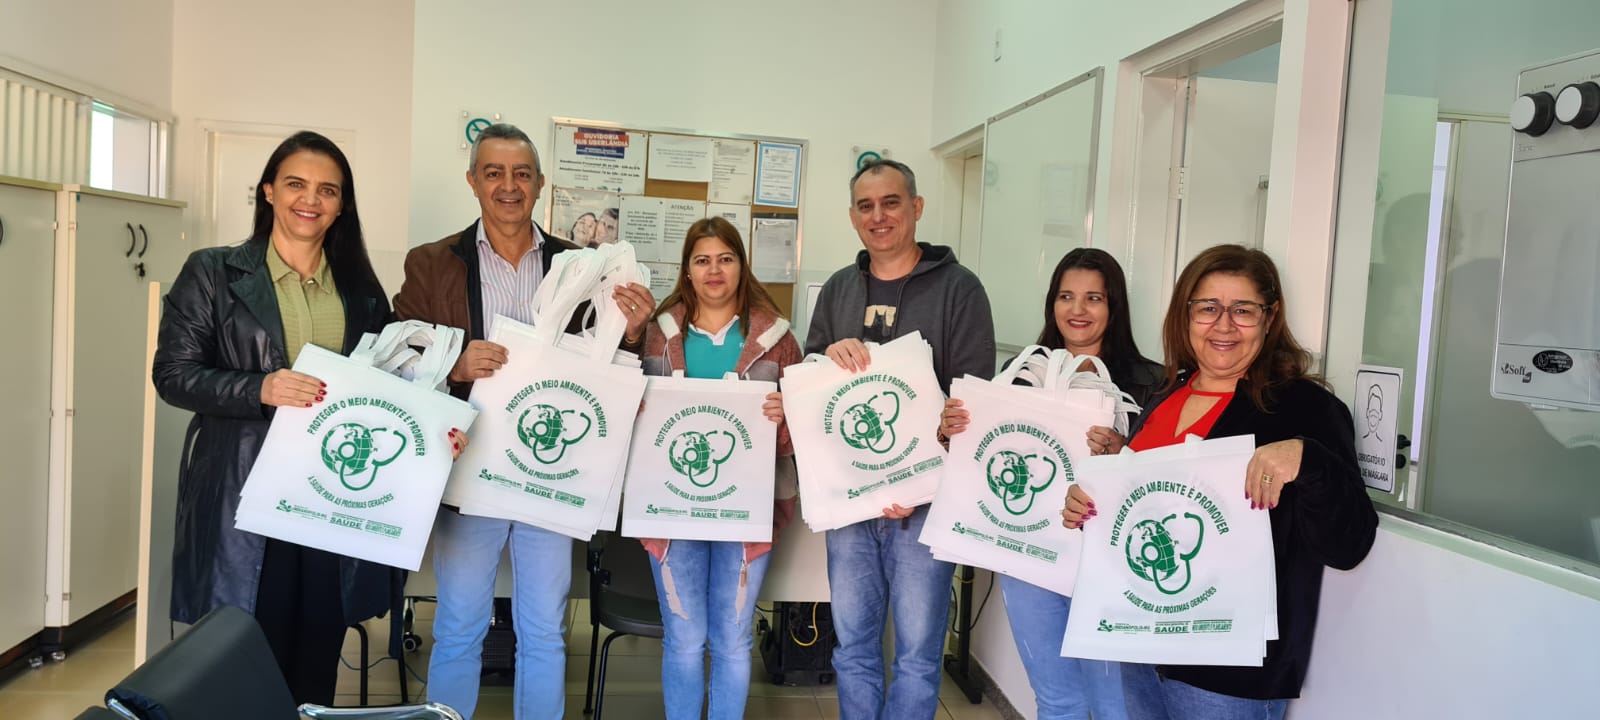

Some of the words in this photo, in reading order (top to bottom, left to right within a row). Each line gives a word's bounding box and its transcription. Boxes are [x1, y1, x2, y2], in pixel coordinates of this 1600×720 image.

[307, 403, 340, 435] PROTEGER
[340, 400, 346, 409] O
[348, 397, 367, 406] MEIO
[369, 398, 407, 419] AMBIENTE
[408, 418, 425, 456] PROMOVER
[506, 384, 535, 413] PROTEGER
[535, 382, 540, 390] O
[542, 380, 558, 388] MEIO
[560, 380, 591, 400] AMBIENTE
[592, 402, 606, 438] PROMOVER
[654, 417, 676, 447] PROTEGER
[680, 406, 696, 417] MEIO
[698, 405, 730, 419] AMBIENTE
[732, 418, 752, 450] PROMOVER
[824, 402, 836, 434] PROTEGER
[836, 384, 850, 397] MEIO
[851, 374, 882, 387] AMBIENTE
[888, 376, 916, 400] PROMOVER
[974, 432, 995, 462] PROTEGER
[999, 424, 1014, 434] MEIO
[1016, 424, 1050, 443] AMBIENTE
[1053, 443, 1074, 482] PROMOVER
[1110, 504, 1130, 546] PROTEGER
[1126, 498, 1133, 508] O
[1130, 486, 1146, 503] MEIO
[1146, 480, 1187, 496] AMBIENTE
[1194, 492, 1230, 535] PROMOVER
[1140, 601, 1154, 612] PARA
[1190, 586, 1216, 608] GERAÇÕES
